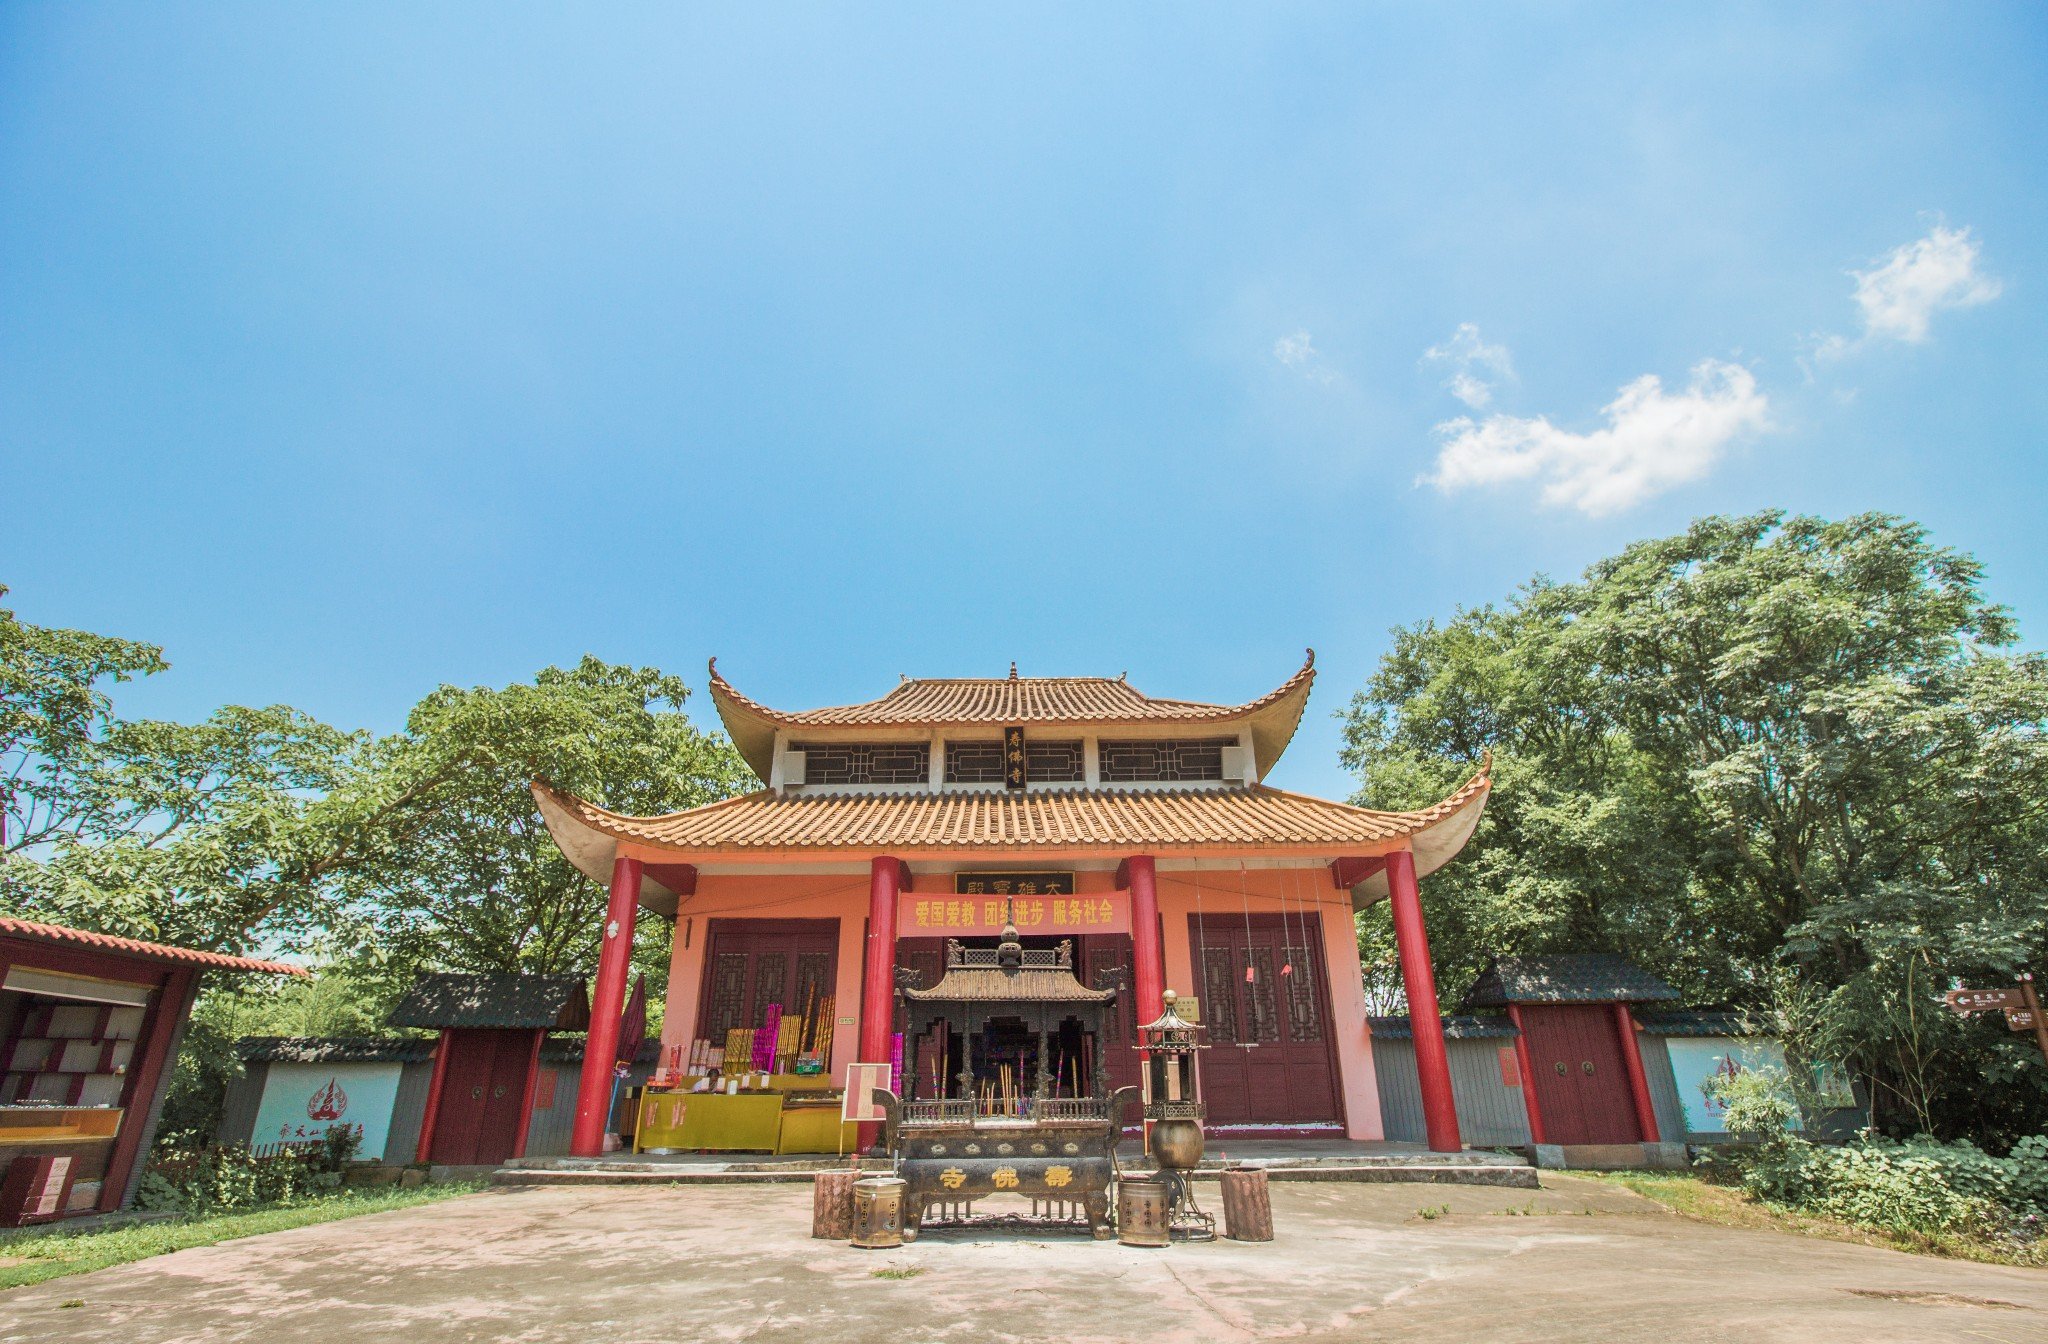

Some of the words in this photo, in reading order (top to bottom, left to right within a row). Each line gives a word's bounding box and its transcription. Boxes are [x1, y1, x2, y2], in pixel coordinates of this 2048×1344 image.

[916, 901, 975, 927] 爱国爱教
[984, 900, 1044, 926] 团结进步
[1053, 898, 1113, 925] 服务社会
